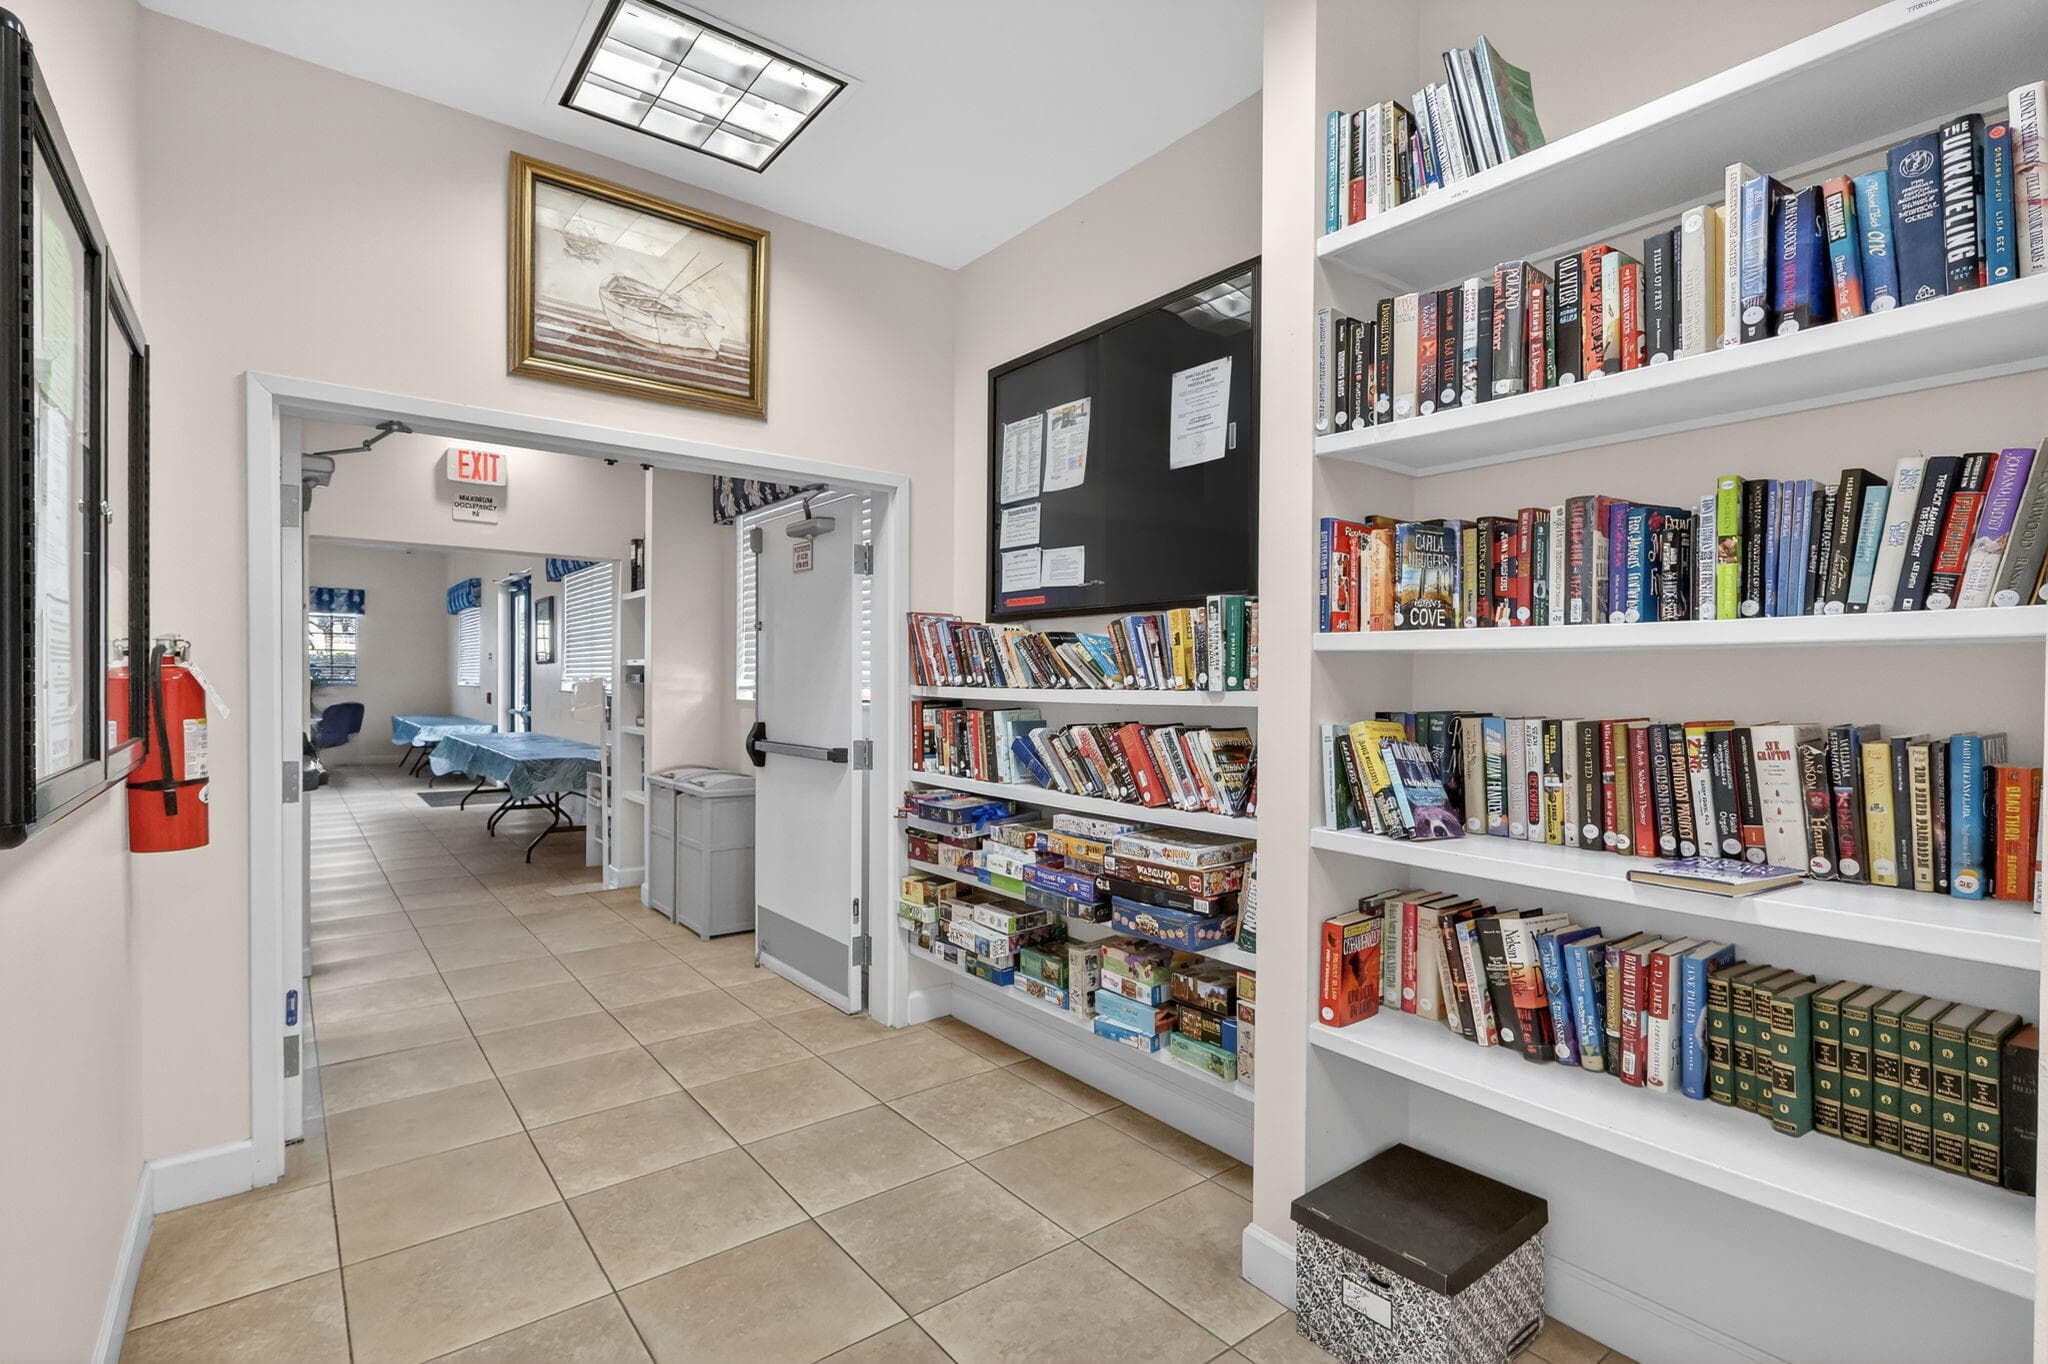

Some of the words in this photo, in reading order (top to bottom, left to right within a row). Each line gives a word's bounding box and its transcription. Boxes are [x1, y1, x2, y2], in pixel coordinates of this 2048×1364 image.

[1943, 120, 1970, 140] THE
[1943, 133, 1976, 264] UNRAVELING
[1503, 268, 1521, 310] POLAND
[1558, 257, 1579, 307] OLIVIER
[1654, 290, 1663, 312] PREY
[1492, 309, 1506, 351] Michener
[458, 450, 500, 483] EXIT
[1936, 474, 1947, 488] THE
[453, 501, 498, 514] OCCUPANCY
[458, 494, 493, 505] MAXIMUM
[1932, 488, 1944, 505] PLOT
[1926, 507, 1939, 537] AGAINST
[1938, 496, 1974, 570] FAITHFUL
[1414, 533, 1445, 553] CARLA
[1911, 520, 1928, 558] PRESIDENT
[1409, 608, 1446, 627] COVE
[1961, 739, 1972, 763] MARY
[1962, 792, 1972, 819] CLARK
[2004, 786, 2021, 813] BRAD
[2004, 814, 2021, 841] THOR
[1503, 929, 1521, 959] Nelson
[1623, 954, 1637, 988] RISING
[1654, 958, 1663, 967] P.
[1655, 970, 1663, 980] D.
[1687, 963, 1696, 988] JANE
[1508, 961, 1527, 997] DeMille
[1624, 989, 1637, 1009] TIDE
[1653, 981, 1664, 1015] JAMES
